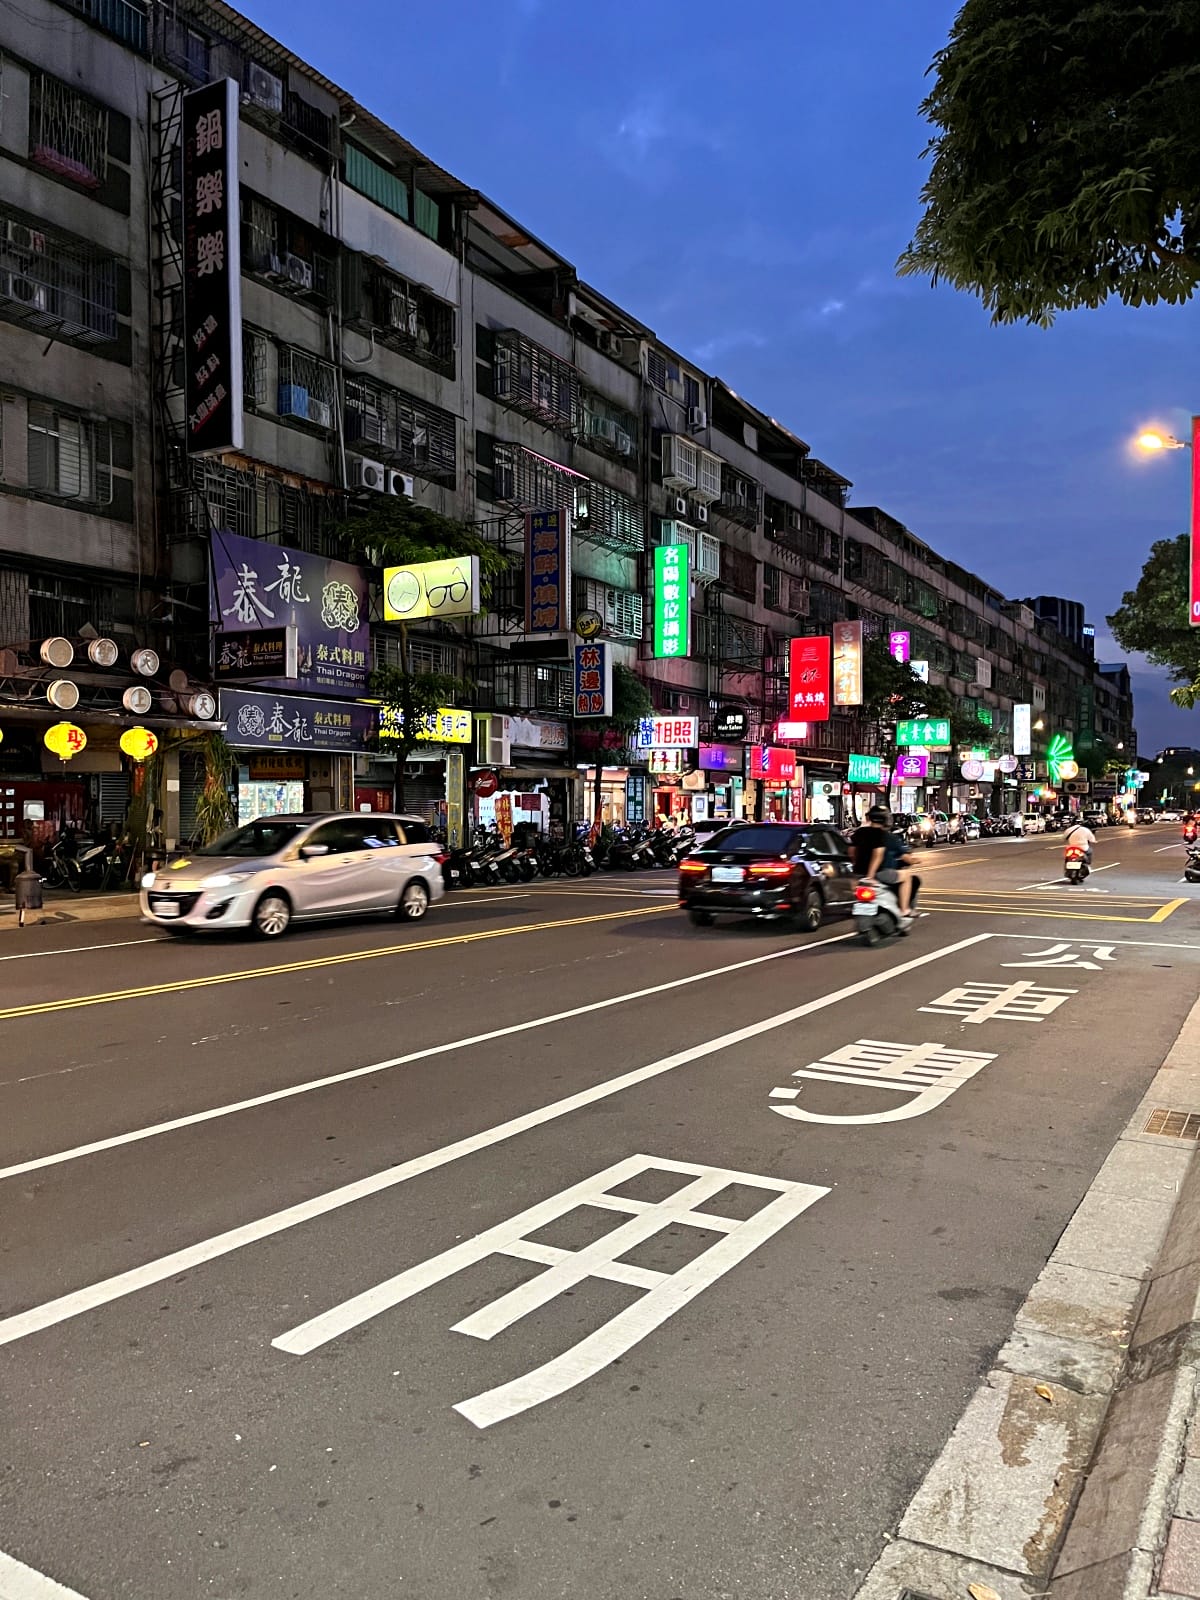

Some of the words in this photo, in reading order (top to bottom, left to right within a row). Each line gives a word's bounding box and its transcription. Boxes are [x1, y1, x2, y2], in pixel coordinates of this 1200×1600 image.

[222, 551, 310, 624] 泰龍
[578, 616, 595, 632] Bar
[217, 641, 252, 668] 泰龍
[316, 643, 365, 667] 泰式料理
[317, 666, 335, 677] Thai
[336, 667, 365, 681] Dragon
[579, 648, 600, 691] 林邊
[266, 702, 312, 742] 泰龍
[313, 712, 351, 727] 泰式料理
[313, 728, 327, 736] Thai
[328, 728, 351, 737] Dragon
